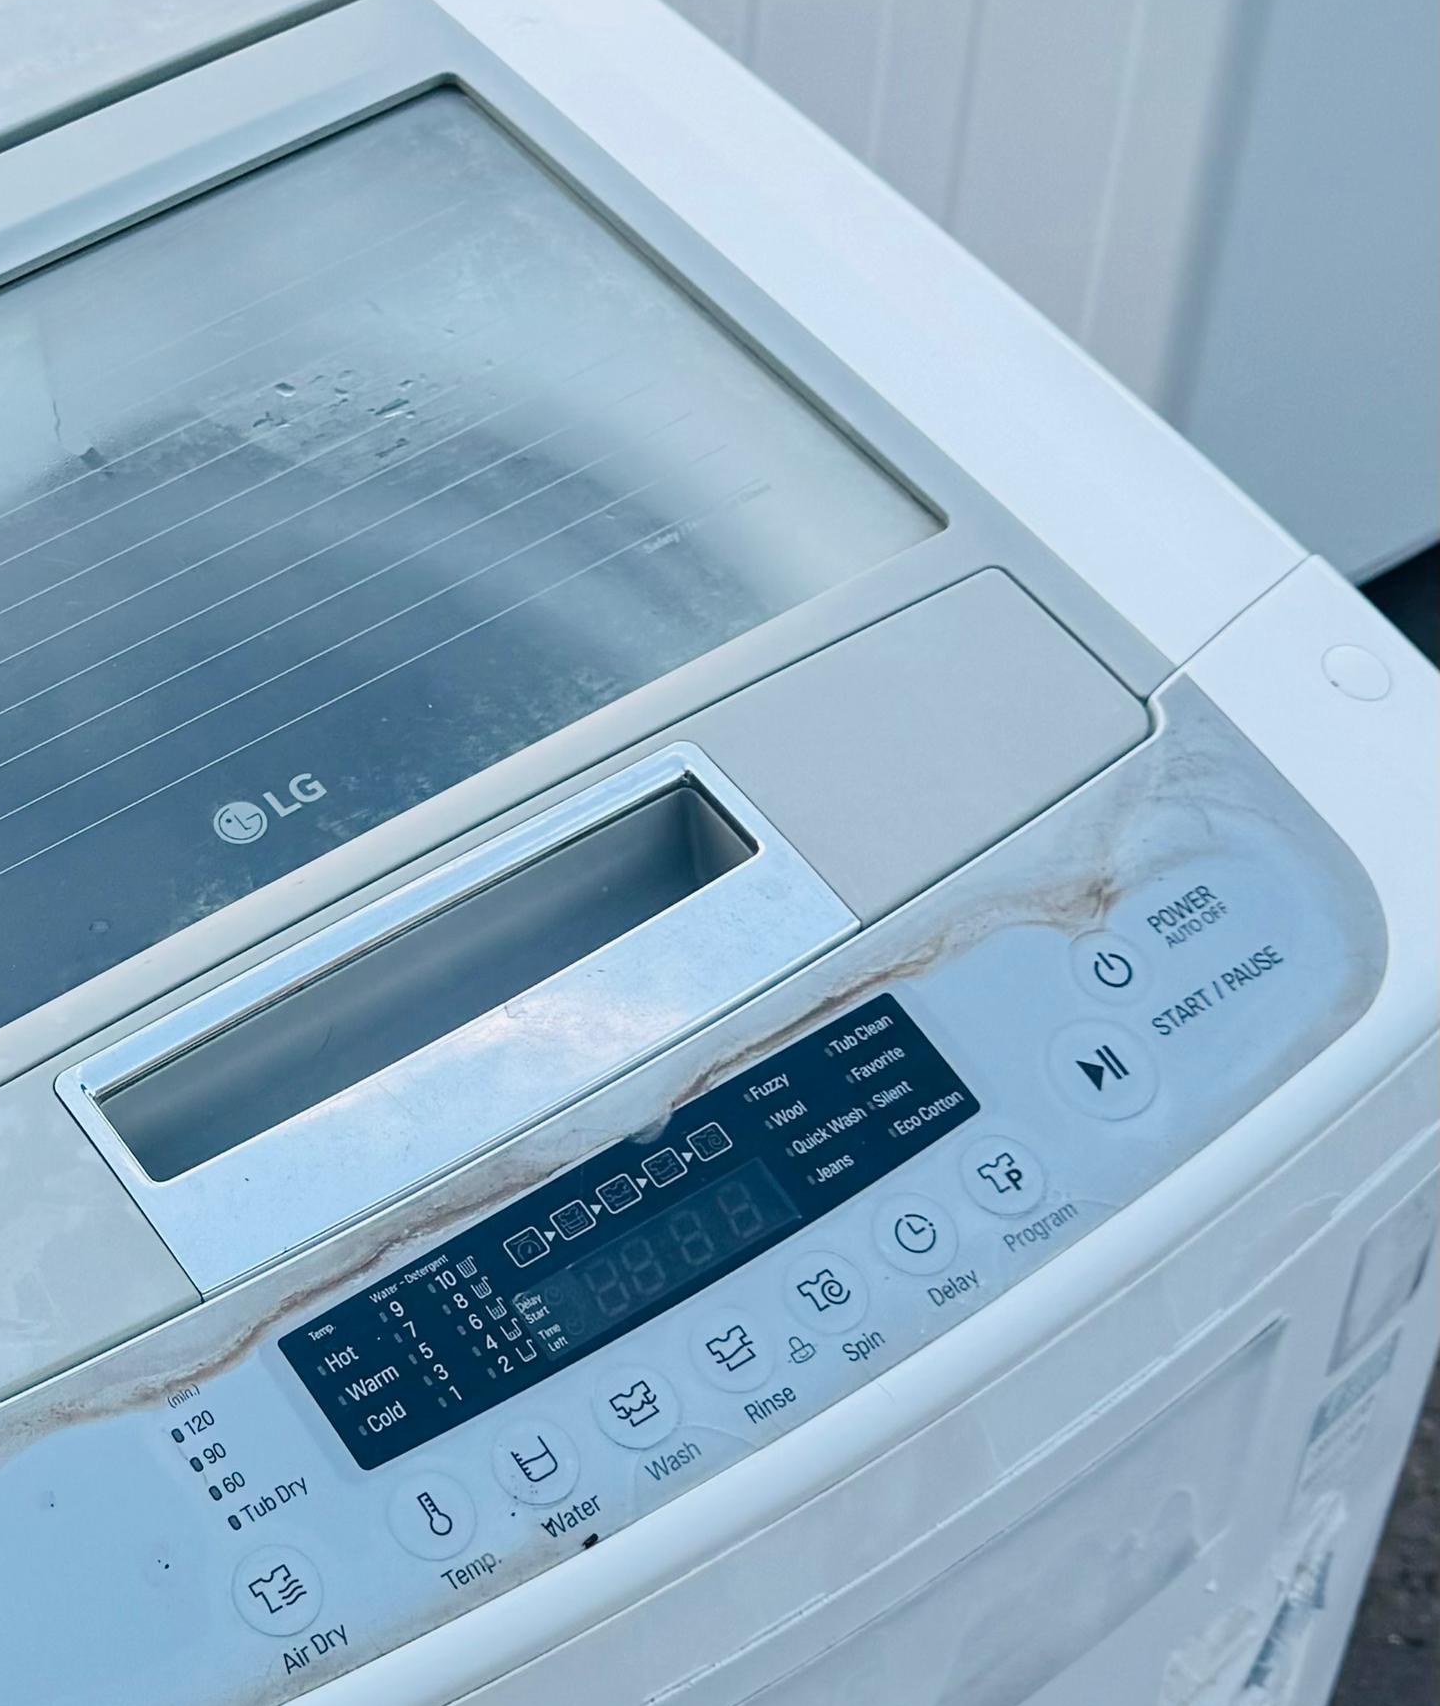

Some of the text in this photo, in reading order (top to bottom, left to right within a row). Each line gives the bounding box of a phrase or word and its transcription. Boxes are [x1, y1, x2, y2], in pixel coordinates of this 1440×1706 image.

[263, 773, 327, 817] LG
[1147, 885, 1218, 933] POWER
[1165, 901, 1229, 949] AUTO OFF
[1152, 988, 1213, 1035] START
[1220, 945, 1284, 991] PAUSE
[829, 1014, 894, 1054] Tub Clean
[850, 1046, 906, 1082] Favorite
[748, 1072, 790, 1101] Fuzzy
[872, 1080, 914, 1109] Silent
[769, 1100, 808, 1127] Wool
[893, 1090, 965, 1136] Eco Cotton
[791, 1106, 868, 1156] Quick Wash
[816, 1153, 855, 1183] Jeans
[1002, 1201, 1080, 1252] Program
[368, 1284, 398, 1304] Water
[404, 1254, 449, 1284] Detergent
[434, 1269, 457, 1290] 10
[926, 1269, 980, 1307] Delay
[389, 1300, 405, 1317] 9
[453, 1293, 469, 1309] 8
[524, 1305, 550, 1324] Start
[402, 1321, 417, 1338] 7
[468, 1313, 484, 1330] 6
[537, 1323, 562, 1341] Time
[418, 1342, 434, 1359] 5
[485, 1334, 498, 1350] 4
[546, 1335, 569, 1353] Left
[841, 1329, 886, 1363] Spin
[324, 1345, 359, 1373] Hot
[433, 1363, 449, 1380] 3
[497, 1355, 514, 1374] 2
[167, 1383, 201, 1410] (min.)
[345, 1365, 400, 1401] Warm
[448, 1385, 462, 1401] 1
[366, 1400, 407, 1433] Cold
[743, 1386, 797, 1425] Rinse
[184, 1410, 215, 1436] 120
[203, 1442, 227, 1465] 90
[644, 1441, 702, 1481] Wash
[222, 1471, 246, 1494] 60
[239, 1477, 309, 1523] Tub Dry
[541, 1494, 601, 1538] Water
[440, 1551, 503, 1590] Temp.
[282, 1624, 348, 1675] Air Dry
